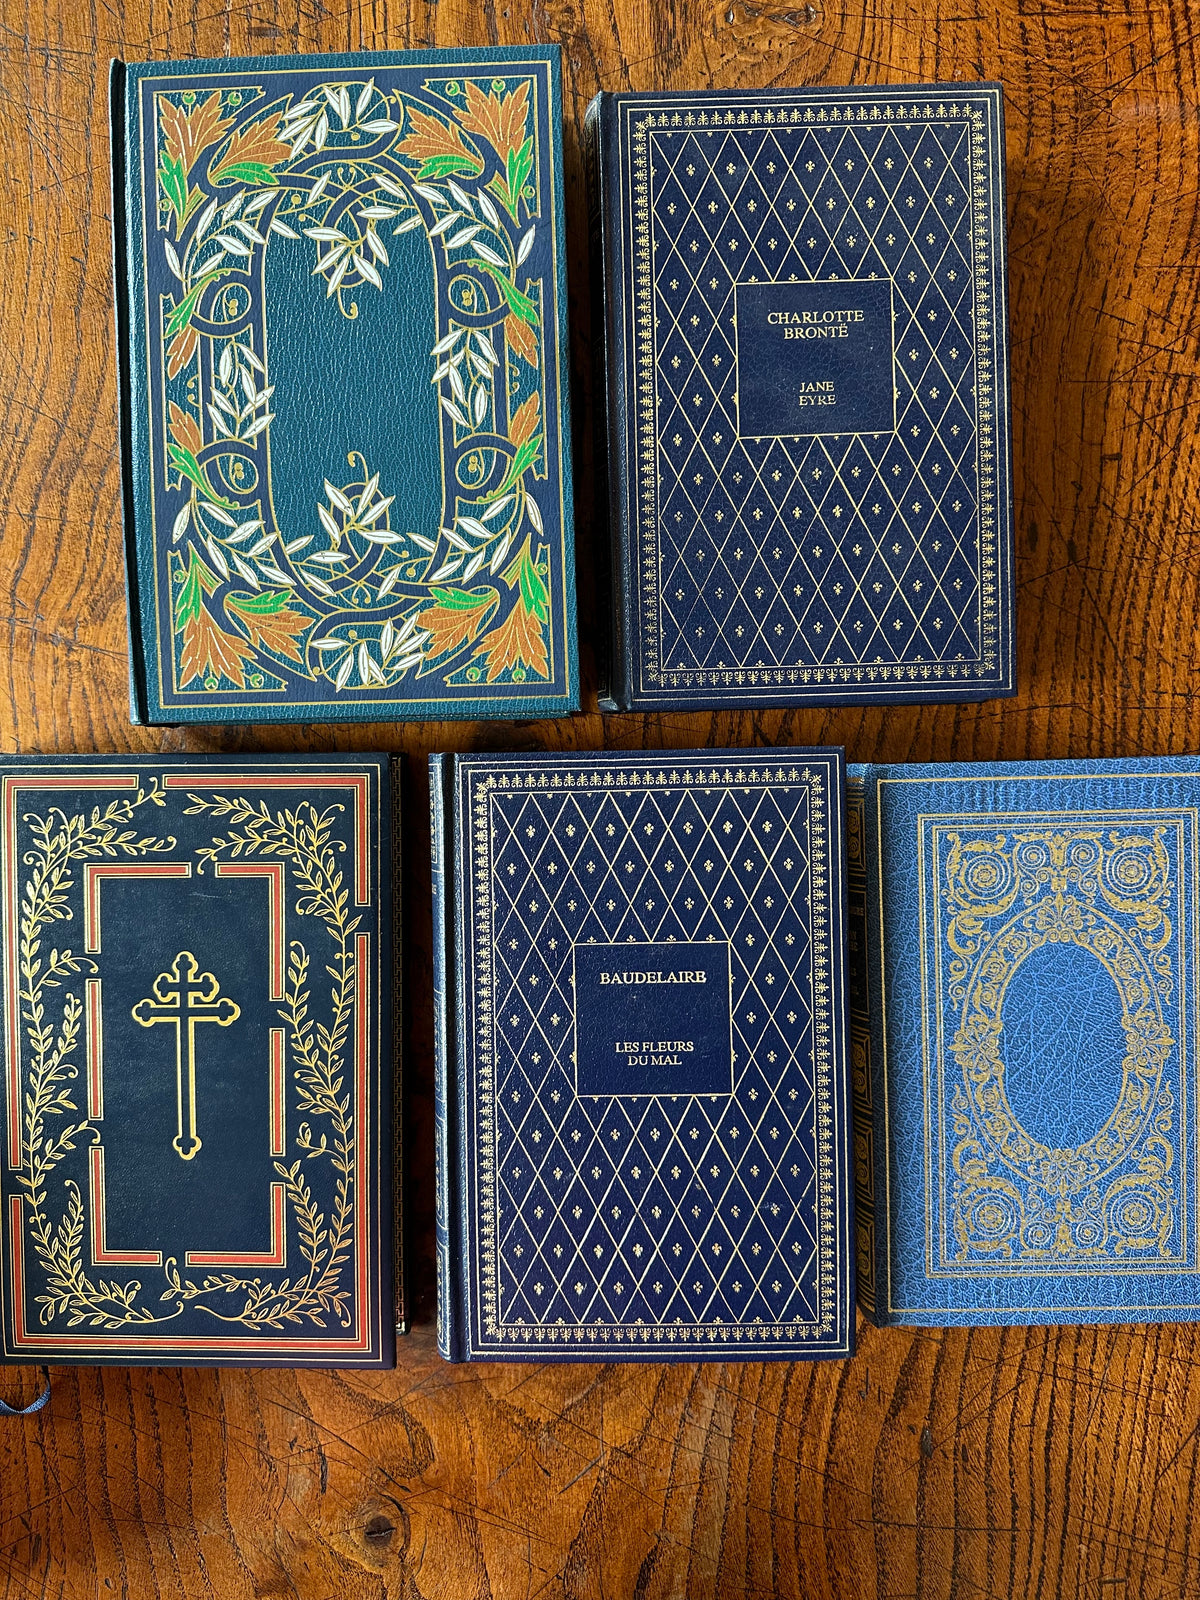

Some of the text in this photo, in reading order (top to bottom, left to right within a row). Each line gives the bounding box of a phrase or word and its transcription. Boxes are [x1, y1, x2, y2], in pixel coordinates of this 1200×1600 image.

[767, 310, 865, 324] CHARLOTTE
[783, 323, 849, 339] BRONTË
[799, 381, 835, 393] JANE
[798, 395, 837, 406] EYRE
[599, 971, 707, 984] BAUDELAIRE
[615, 1041, 694, 1053] LES FLEURS
[627, 1055, 683, 1066] DU MAL
